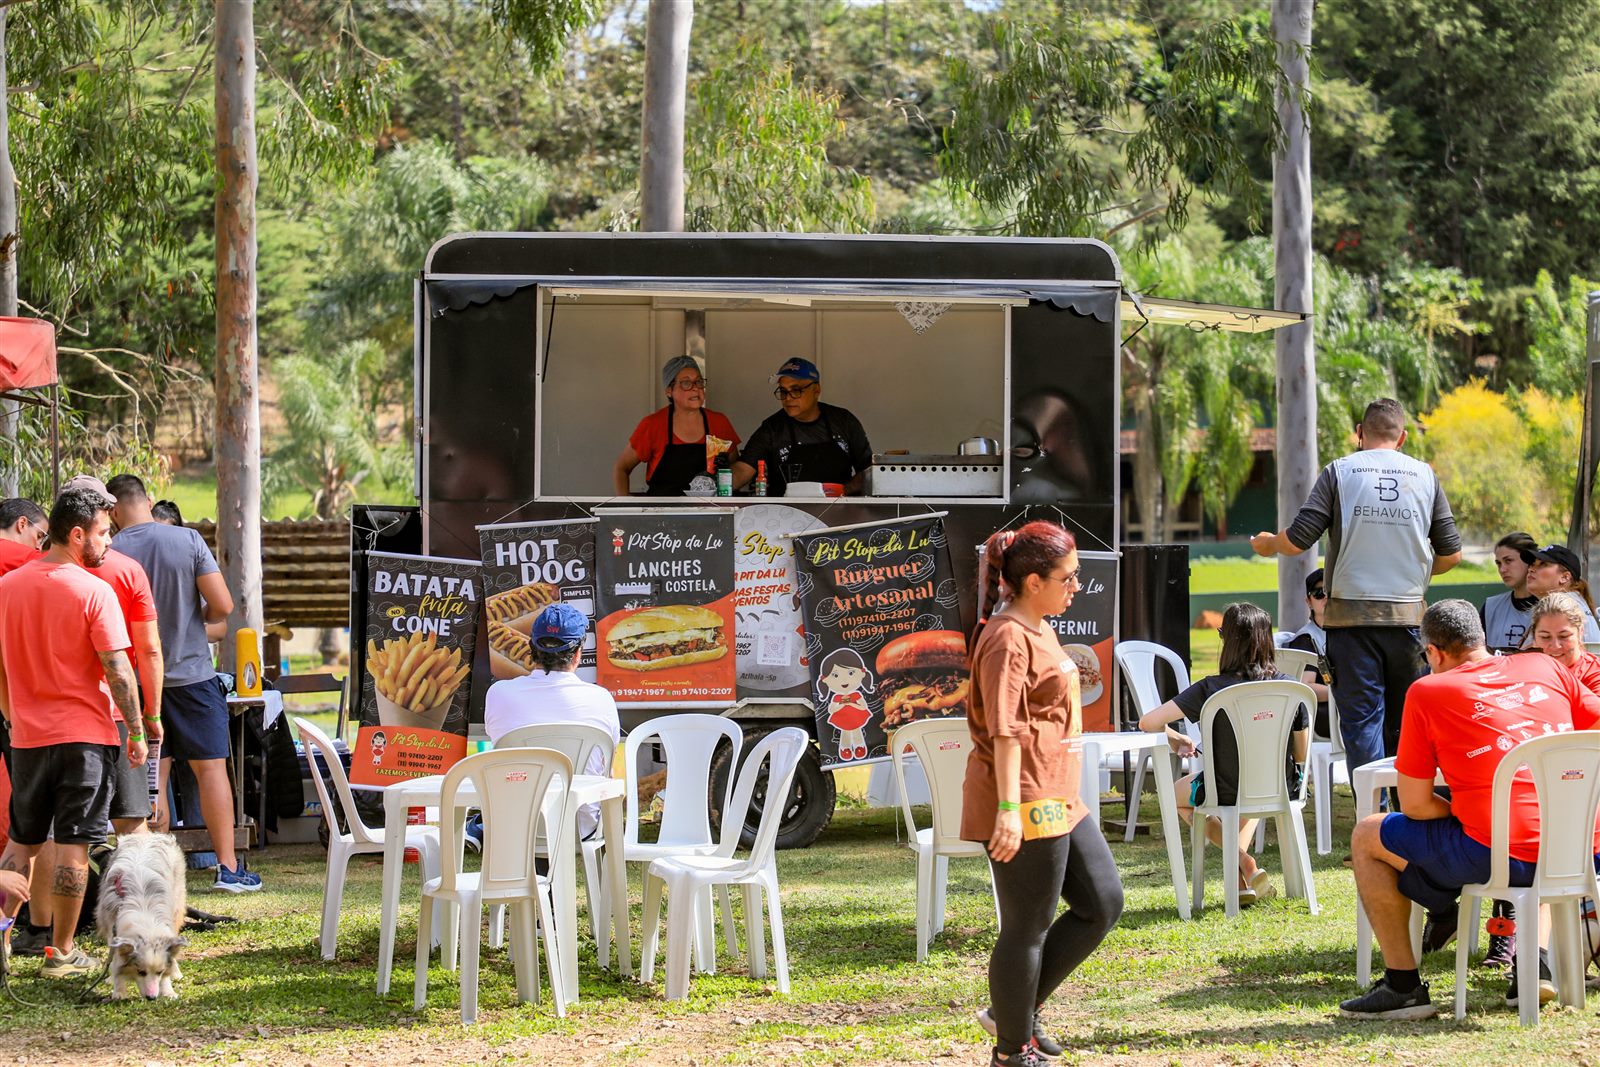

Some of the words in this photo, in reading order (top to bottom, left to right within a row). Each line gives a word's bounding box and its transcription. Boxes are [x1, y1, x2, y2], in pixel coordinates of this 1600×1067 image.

[1381, 468, 1418, 477] BEHAVIOR
[627, 532, 651, 551] Pit
[651, 532, 682, 553] Stop
[685, 534, 703, 550] da
[705, 533, 723, 550] Lu
[742, 531, 785, 564] Stop
[812, 543, 839, 567] Pit
[843, 538, 880, 562] Stop
[883, 533, 904, 553] da
[907, 529, 930, 550] Lu
[495, 539, 559, 567] HOT
[520, 559, 586, 586] DOG
[628, 559, 702, 579] LANCHES
[740, 571, 756, 581] PIT
[756, 569, 771, 579] DA
[773, 568, 786, 578] LU
[833, 561, 923, 587] Burguer
[374, 570, 476, 602] BATATA
[563, 589, 591, 597] SIMPLES
[665, 579, 717, 593] COSTELA
[753, 583, 791, 595] FESTAS
[830, 580, 934, 612] Artesanal
[1086, 578, 1105, 595] Lu
[418, 593, 467, 619] frita
[392, 615, 451, 637] CONE
[838, 608, 916, 629] (11)97410-2207
[1050, 620, 1099, 636] PERNIL
[842, 621, 916, 640] (11)91947-1967
[438, 738, 451, 750] Lu
[408, 752, 443, 761] 97410-2207
[408, 761, 442, 770] 91947-1967
[375, 768, 407, 777] FAZEMOS
[1029, 803, 1064, 825] 058
